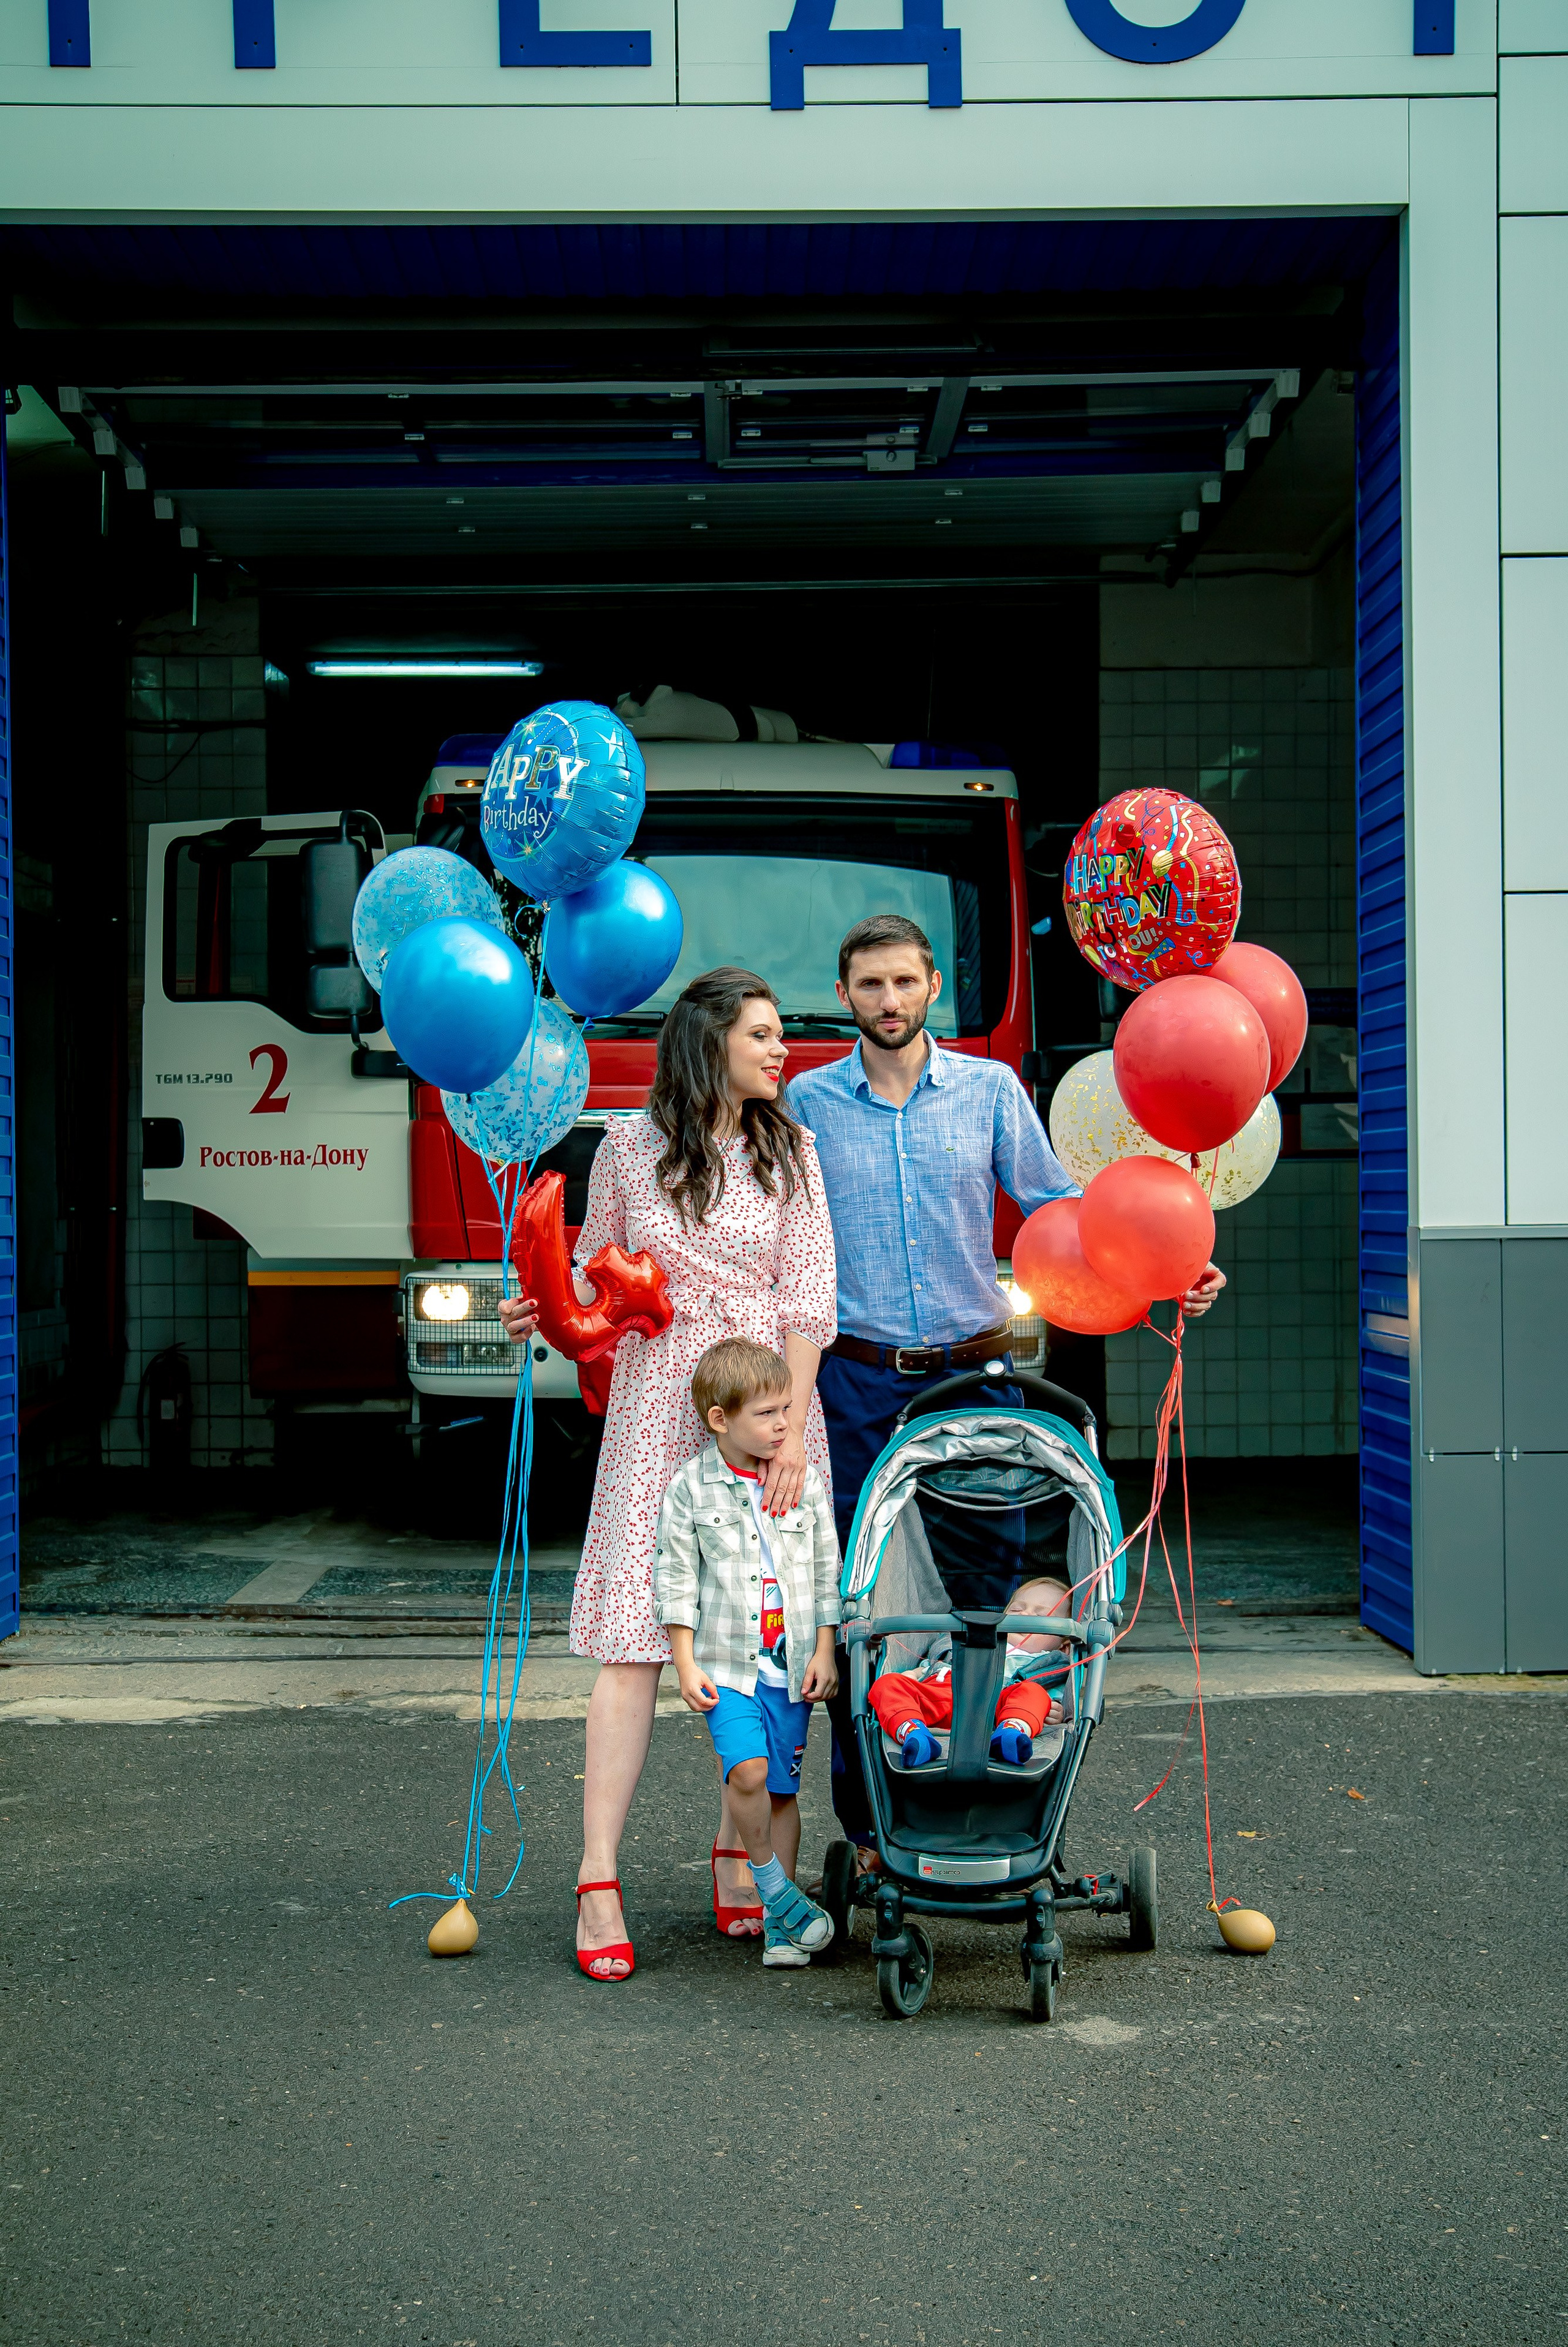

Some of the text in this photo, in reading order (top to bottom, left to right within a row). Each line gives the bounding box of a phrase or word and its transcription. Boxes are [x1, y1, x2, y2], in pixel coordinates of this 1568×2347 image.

[484, 796, 553, 838] Birthday
[1073, 846, 1147, 895] HAPPY
[1097, 927, 1159, 960] TO YOU!
[155, 1074, 183, 1084] TGM
[249, 1043, 291, 1114] 2
[199, 1143, 369, 1171] Ростов-на-Дону
